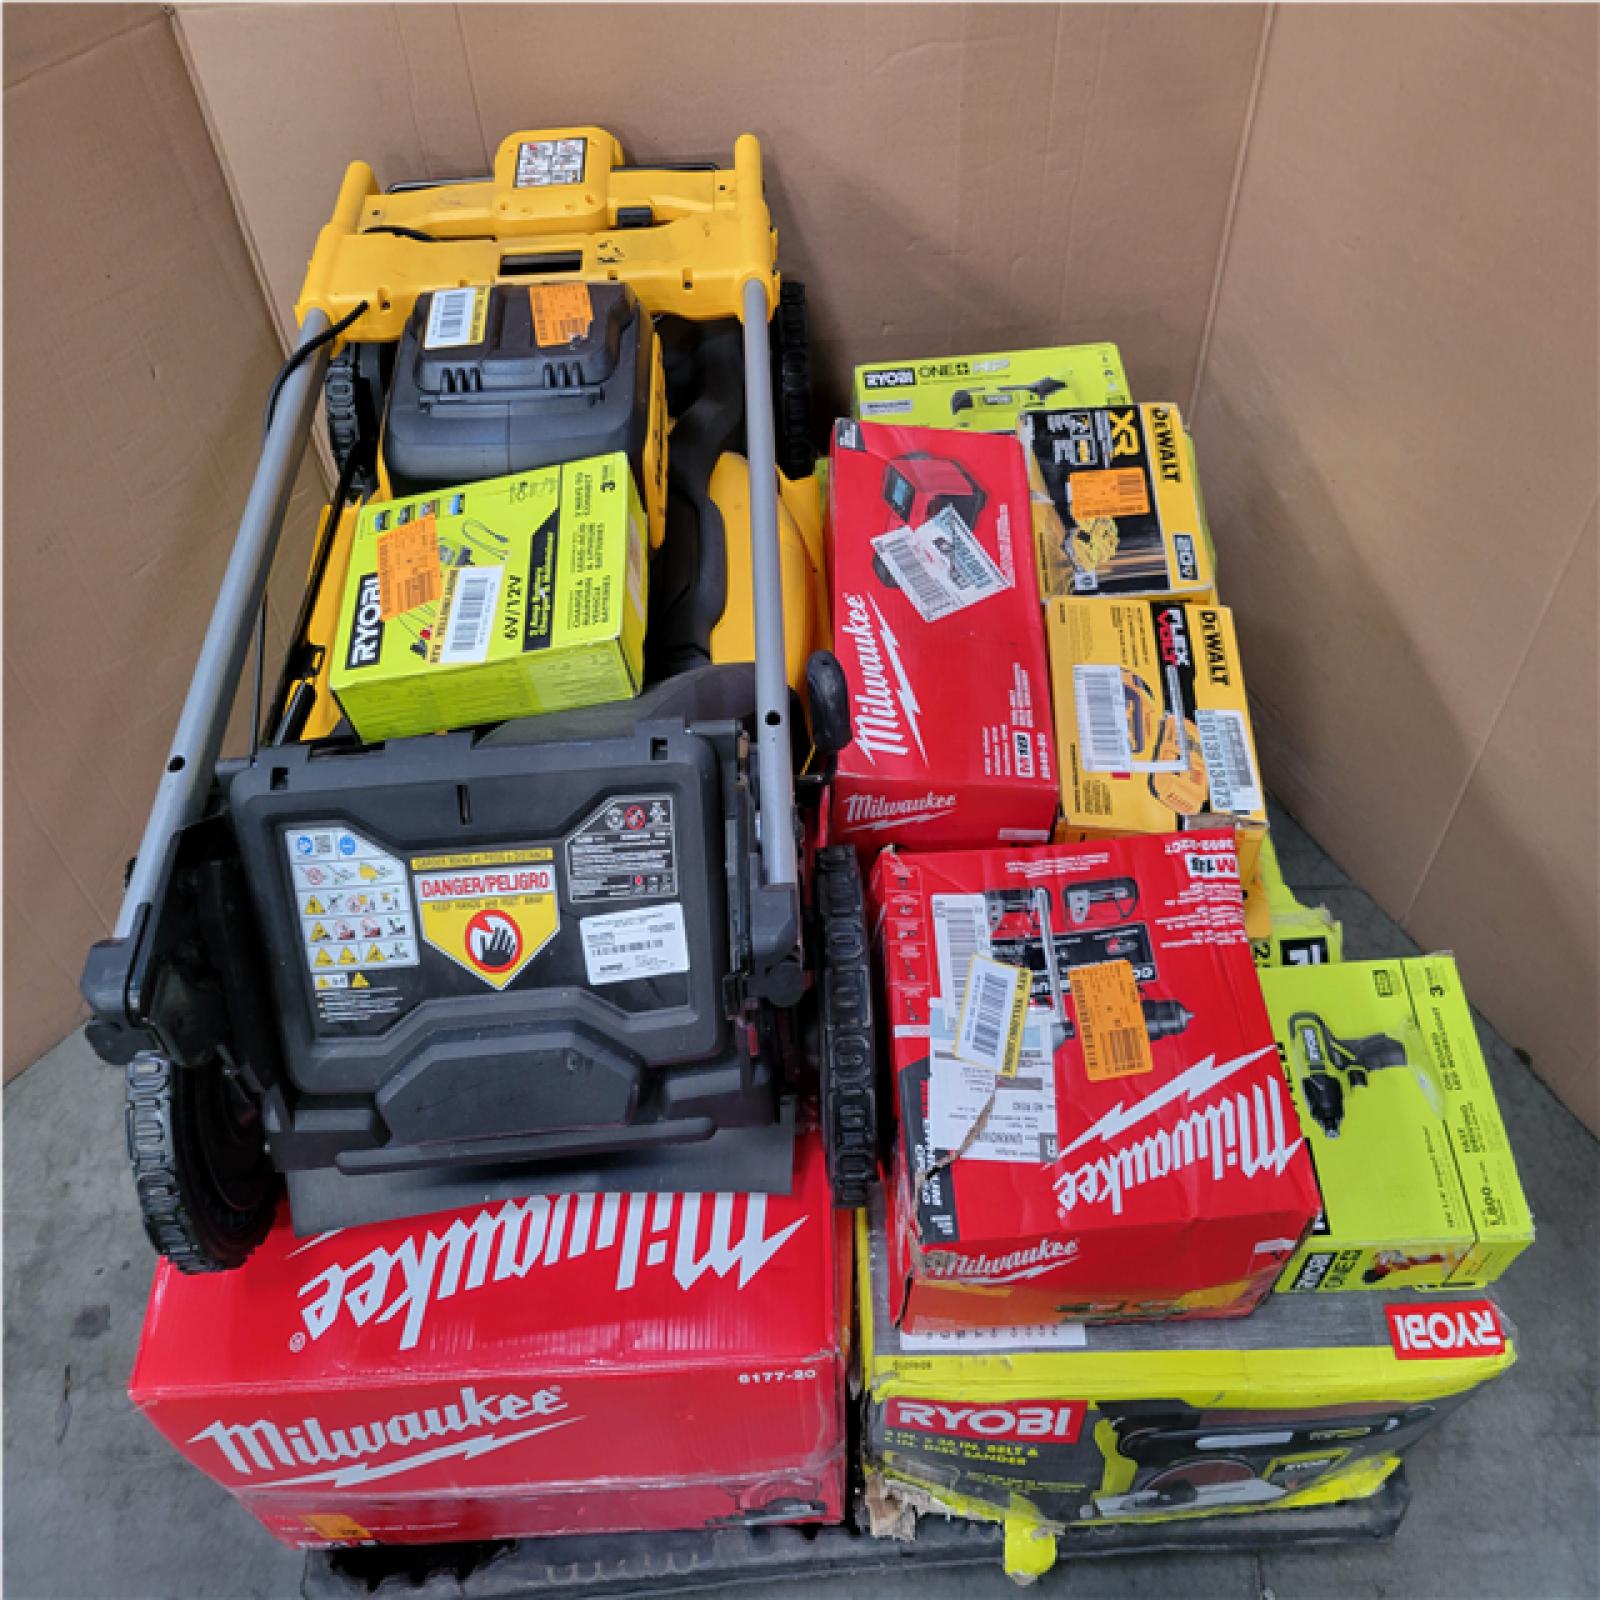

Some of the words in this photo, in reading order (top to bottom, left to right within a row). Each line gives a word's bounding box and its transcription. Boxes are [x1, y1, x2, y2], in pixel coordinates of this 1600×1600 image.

[1109, 409, 1141, 459] XR
[503, 574, 522, 640] 6V/12V
[842, 594, 909, 766] Milwaukee
[845, 791, 958, 822] Milwaukee
[1053, 1074, 1302, 1216] Milwaukee
[298, 1192, 808, 1351] Milwaukee
[1397, 1309, 1503, 1351] RYOBI
[186, 1386, 567, 1475] Milwaukee
[896, 1401, 1071, 1436] RYOBI
